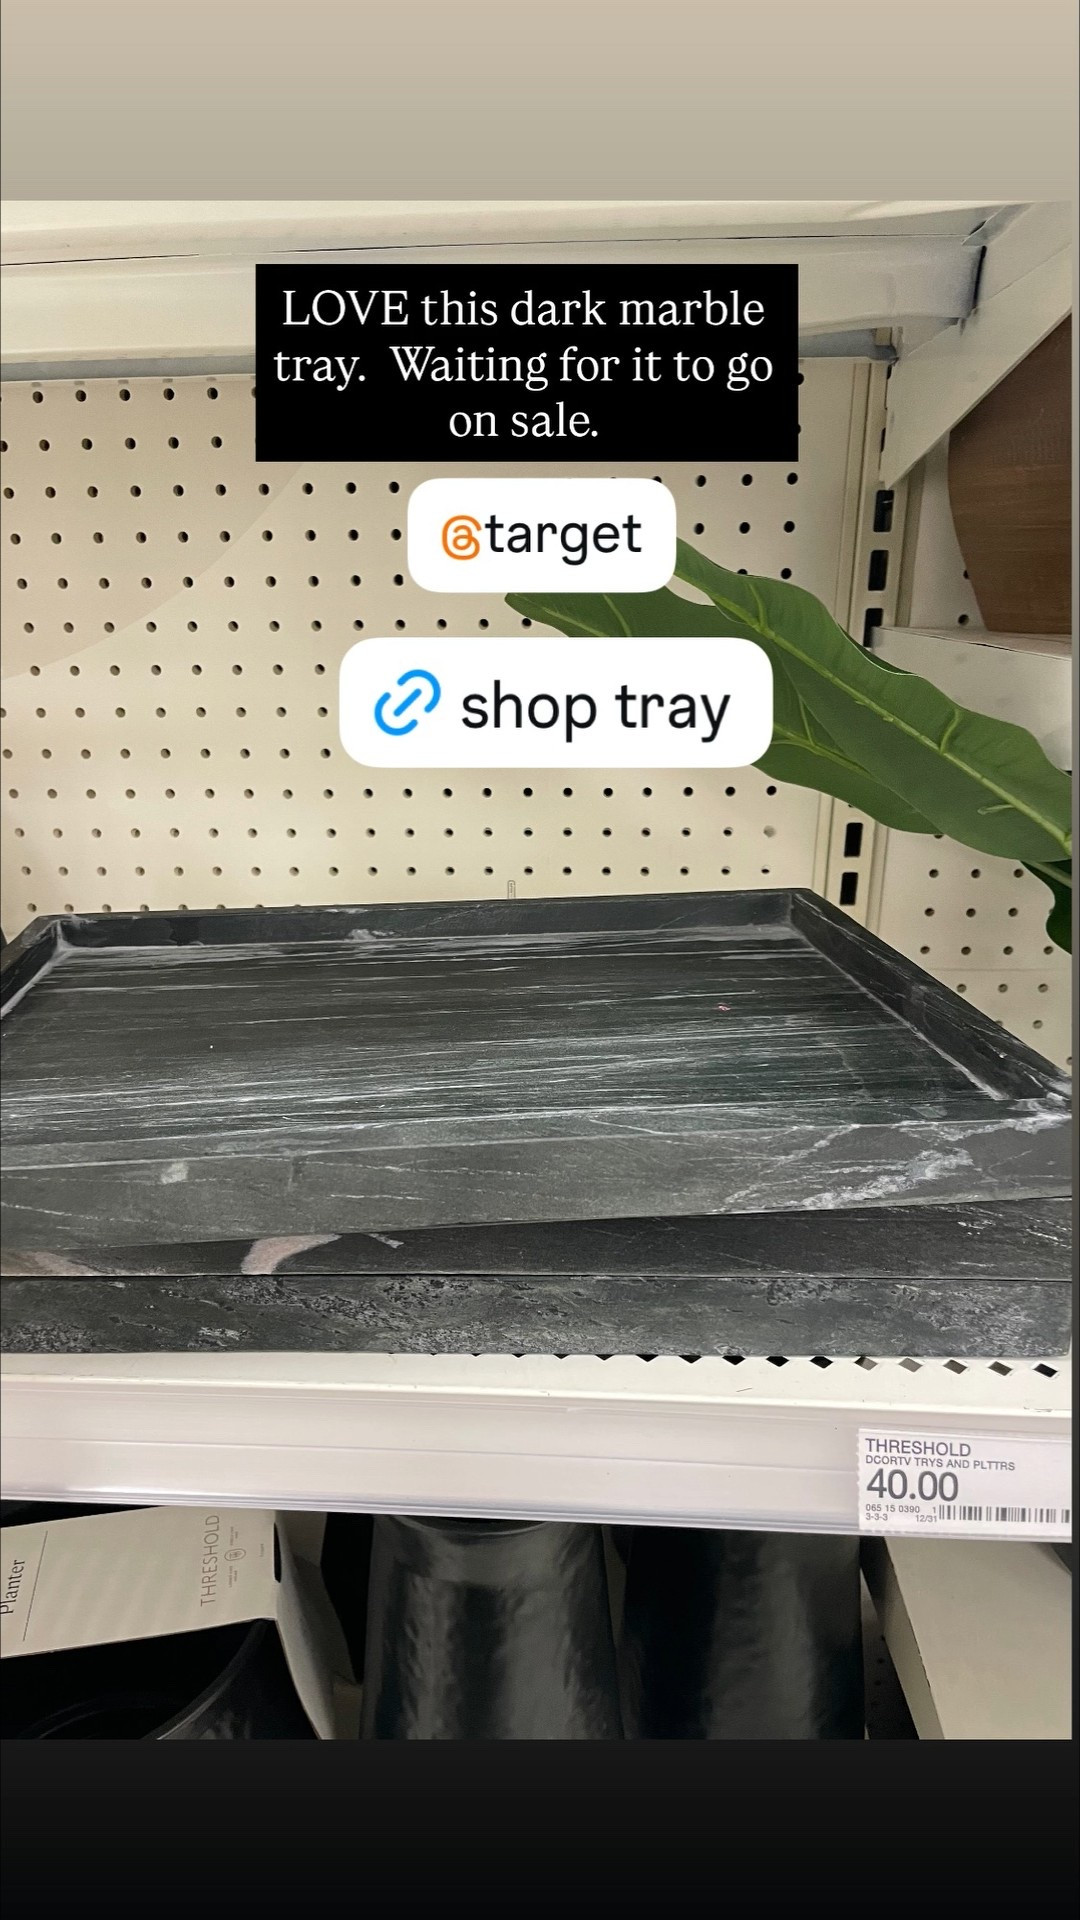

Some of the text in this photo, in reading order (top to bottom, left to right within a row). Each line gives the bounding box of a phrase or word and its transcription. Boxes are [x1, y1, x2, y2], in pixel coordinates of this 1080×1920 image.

[865, 1438, 971, 1457] THRESHOLD
[865, 1455, 1015, 1471] DCORTV TRYS AND PLTTRS
[866, 1468, 959, 1502] 40.00
[865, 1503, 937, 1514] 065 15 0390 1
[865, 1512, 938, 1523] 3-3-3 12/31
[200, 1514, 220, 1607] THRESHOLD
[0, 1559, 26, 1615] Planter
